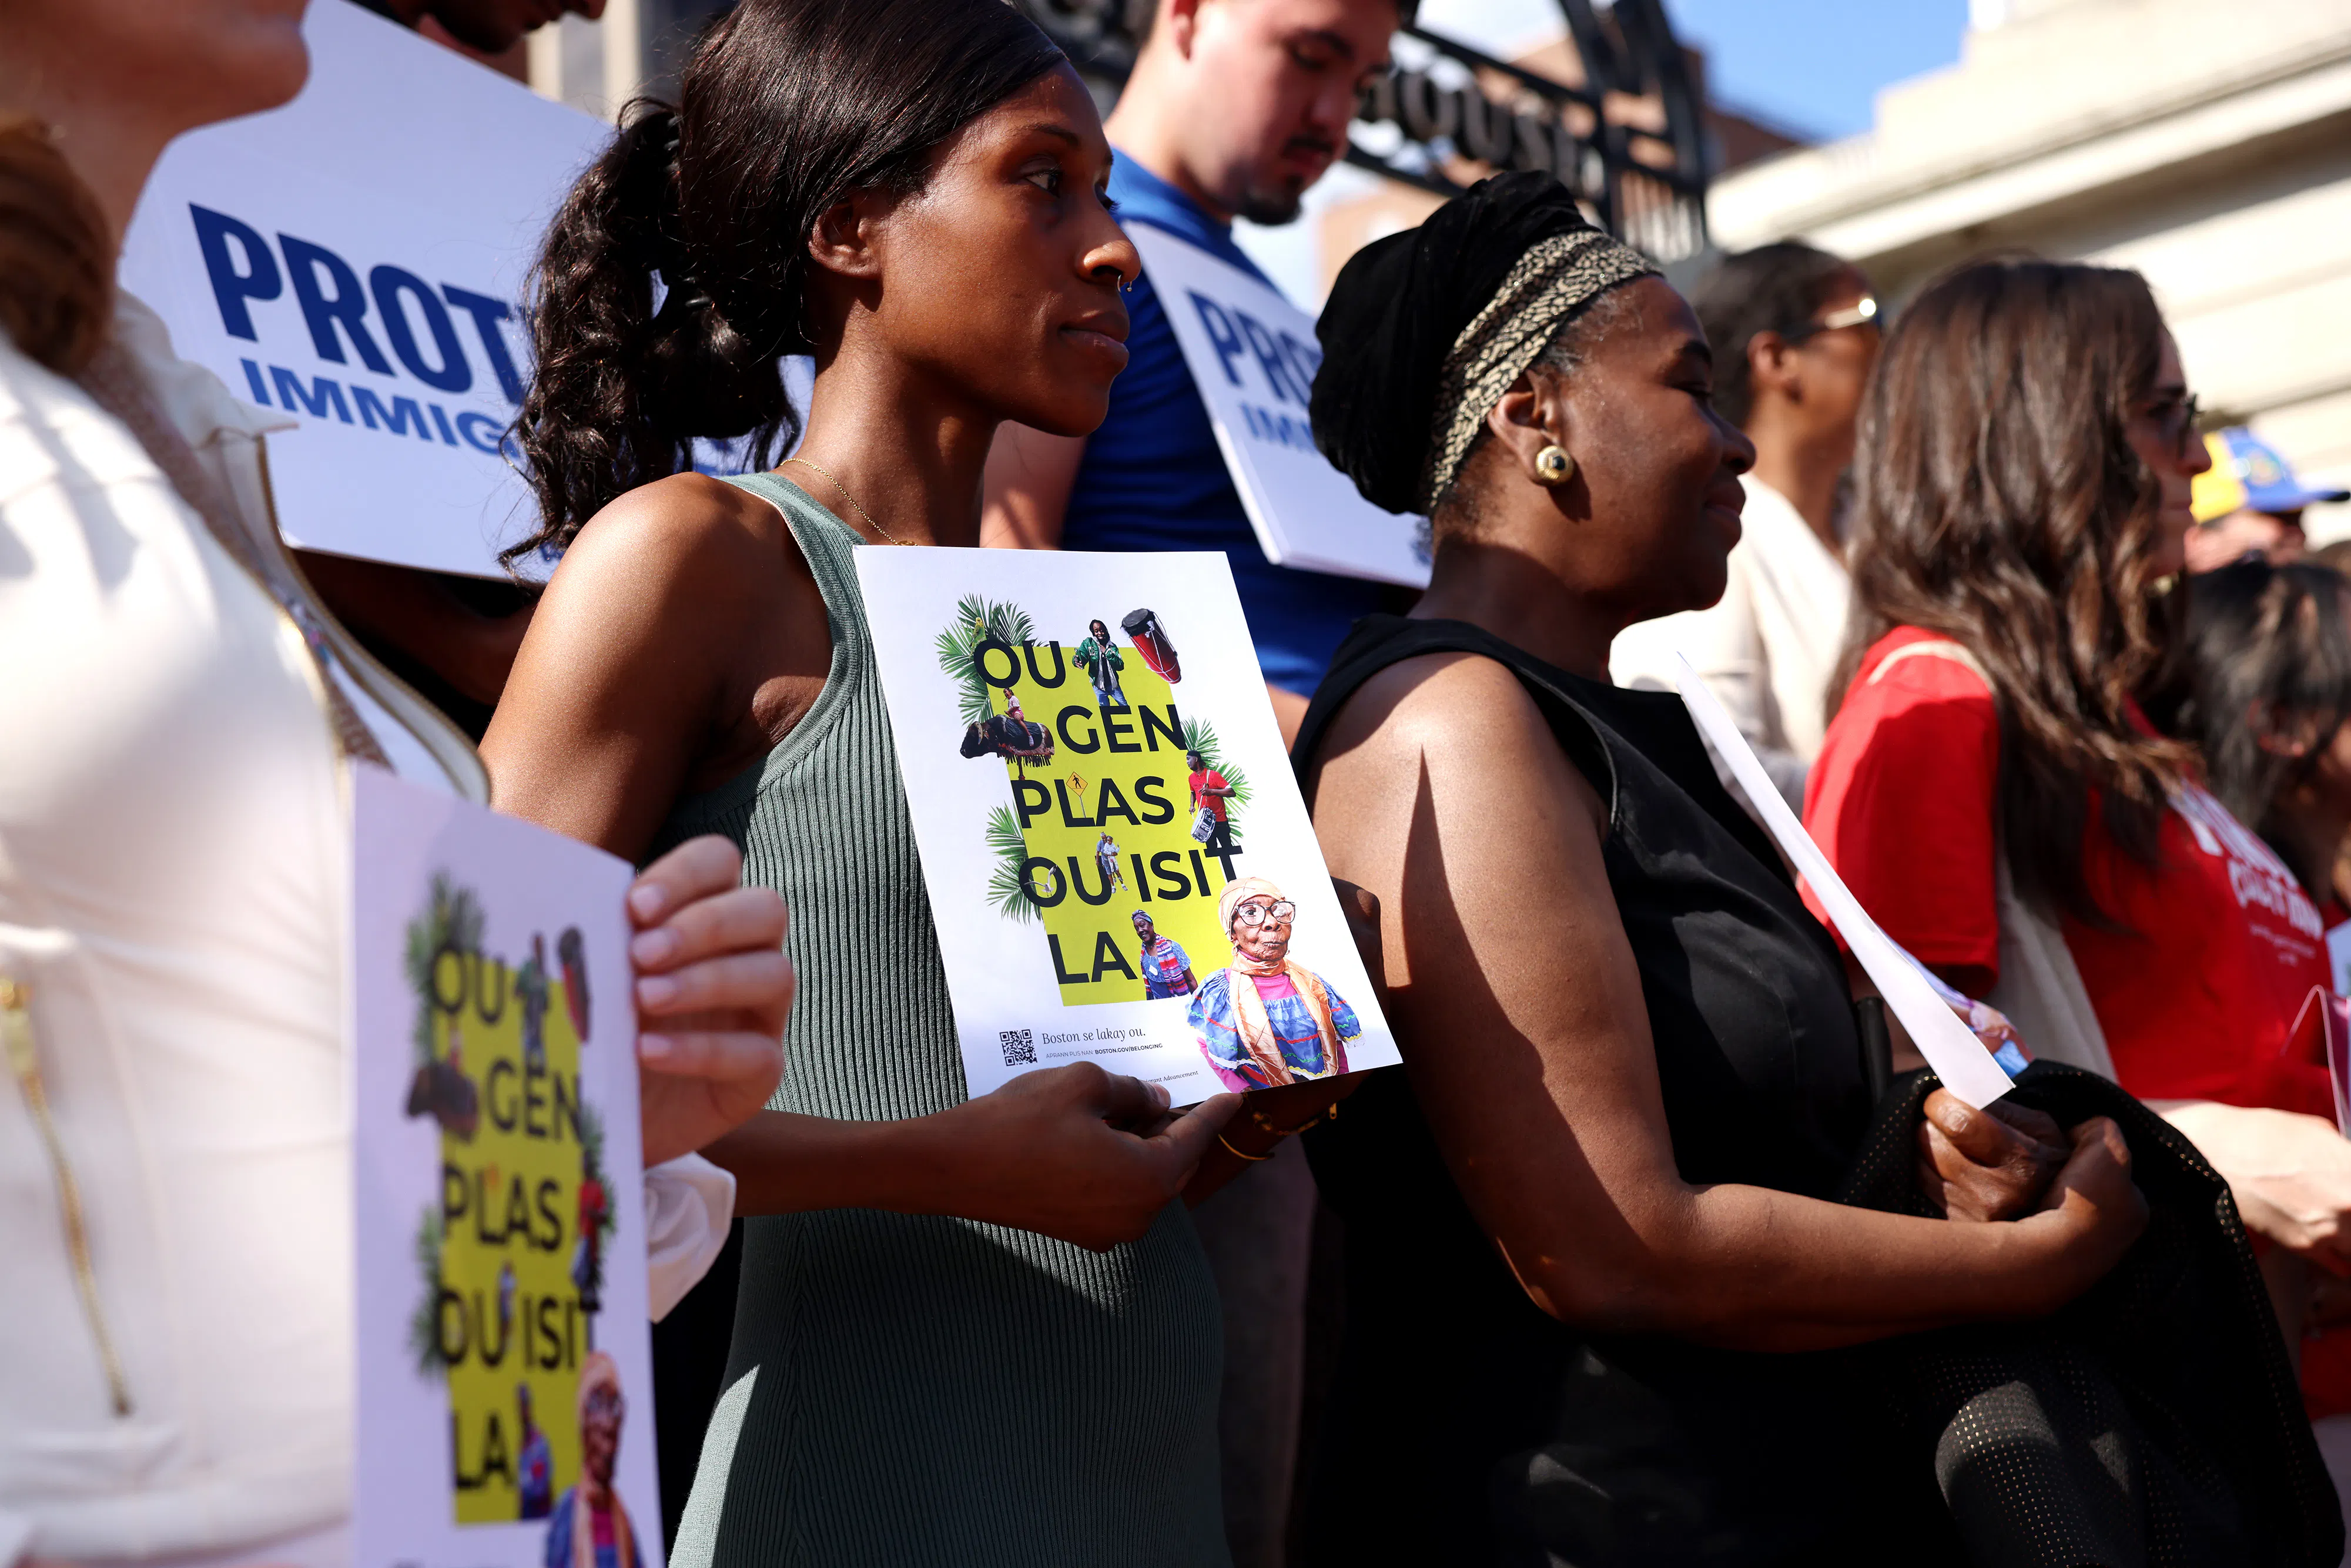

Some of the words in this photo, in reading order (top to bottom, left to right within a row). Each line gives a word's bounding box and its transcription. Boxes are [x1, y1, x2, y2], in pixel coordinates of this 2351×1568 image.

[973, 633, 1066, 689] OU
[1056, 704, 1188, 755] GEN
[1010, 776, 1175, 829] PLAS
[1019, 855, 1113, 908] OU
[1130, 845, 1244, 903] ISIT
[433, 940, 506, 1026] OU
[1047, 931, 1138, 985] LA
[1041, 1032, 1081, 1045] Boston
[1083, 1032, 1094, 1041] se
[1096, 1028, 1126, 1042] lakay
[1128, 1028, 1146, 1038] ou.
[1094, 1043, 1163, 1055] BOSTON.GOV/BELONGING
[487, 1058, 582, 1143] GEN
[1163, 1070, 1198, 1081] Advancement
[441, 1164, 562, 1252] PLAS
[437, 1289, 508, 1366] OU
[451, 1412, 515, 1491] LA
